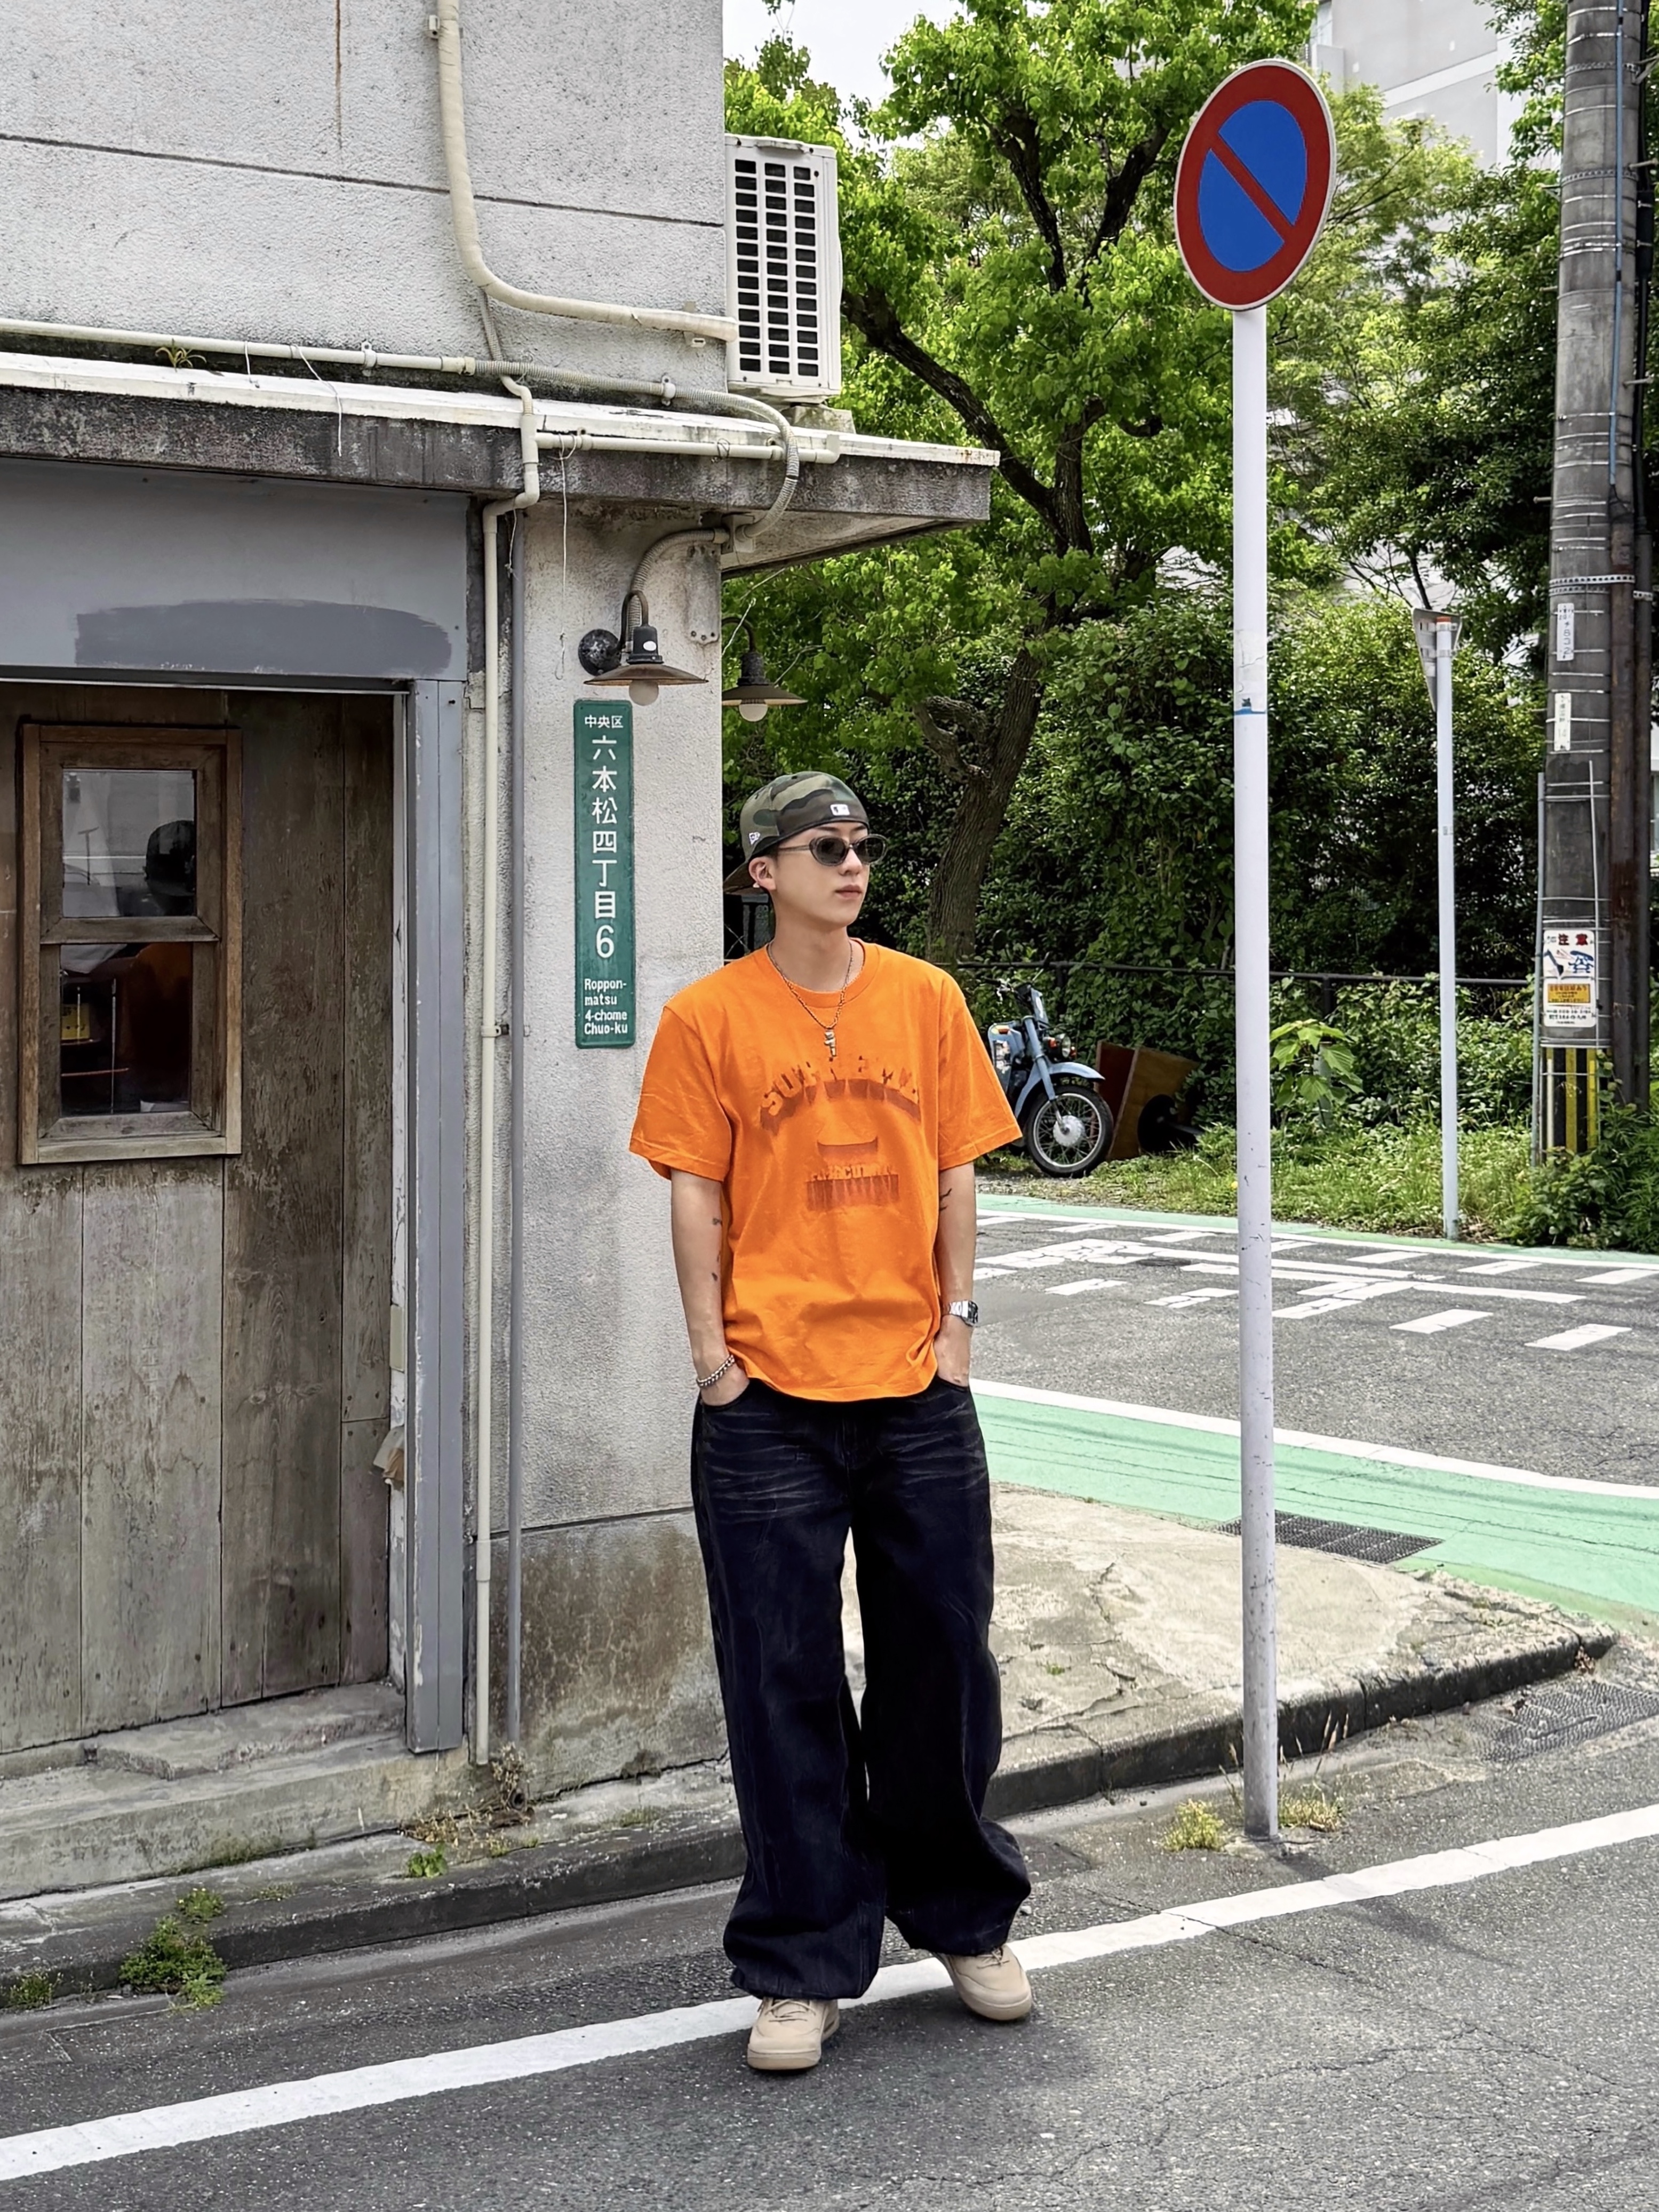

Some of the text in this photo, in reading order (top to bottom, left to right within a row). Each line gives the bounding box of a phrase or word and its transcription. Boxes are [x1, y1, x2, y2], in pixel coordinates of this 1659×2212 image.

[584, 715, 624, 728] 中央区
[584, 978, 627, 993] Roppon-
[584, 993, 618, 1006] matsu
[585, 1009, 627, 1021] 4-chome
[584, 1022, 628, 1035] Chuo-ku
